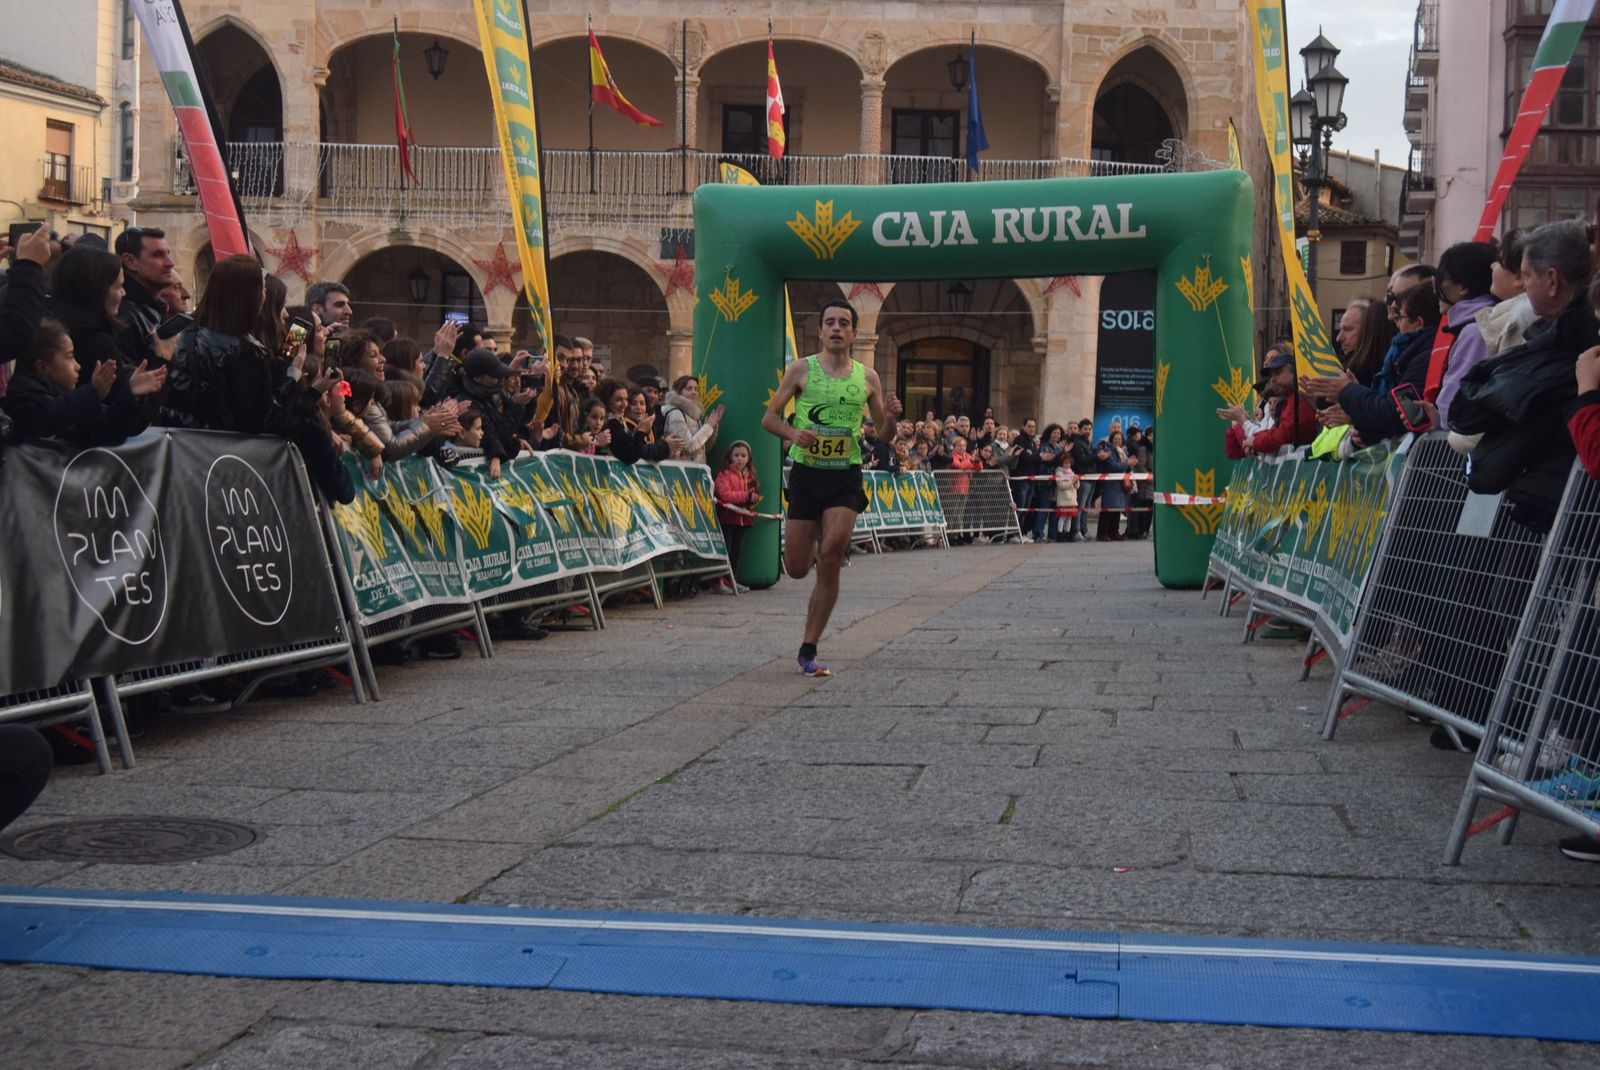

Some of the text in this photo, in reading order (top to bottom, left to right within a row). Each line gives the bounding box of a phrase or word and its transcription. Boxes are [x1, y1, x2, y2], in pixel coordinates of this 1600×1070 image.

[872, 203, 1146, 248] CAJA RURAL
[809, 440, 845, 457] 854
[83, 486, 129, 518] IM
[221, 487, 260, 516] IM
[67, 528, 157, 566] PLAN
[216, 525, 282, 555] PLAN
[533, 541, 555, 556] RURAL
[483, 550, 510, 568] RURAL
[95, 571, 153, 606] TES
[236, 563, 282, 592] TES
[353, 568, 387, 592] CAJA
[371, 587, 385, 600] DE
